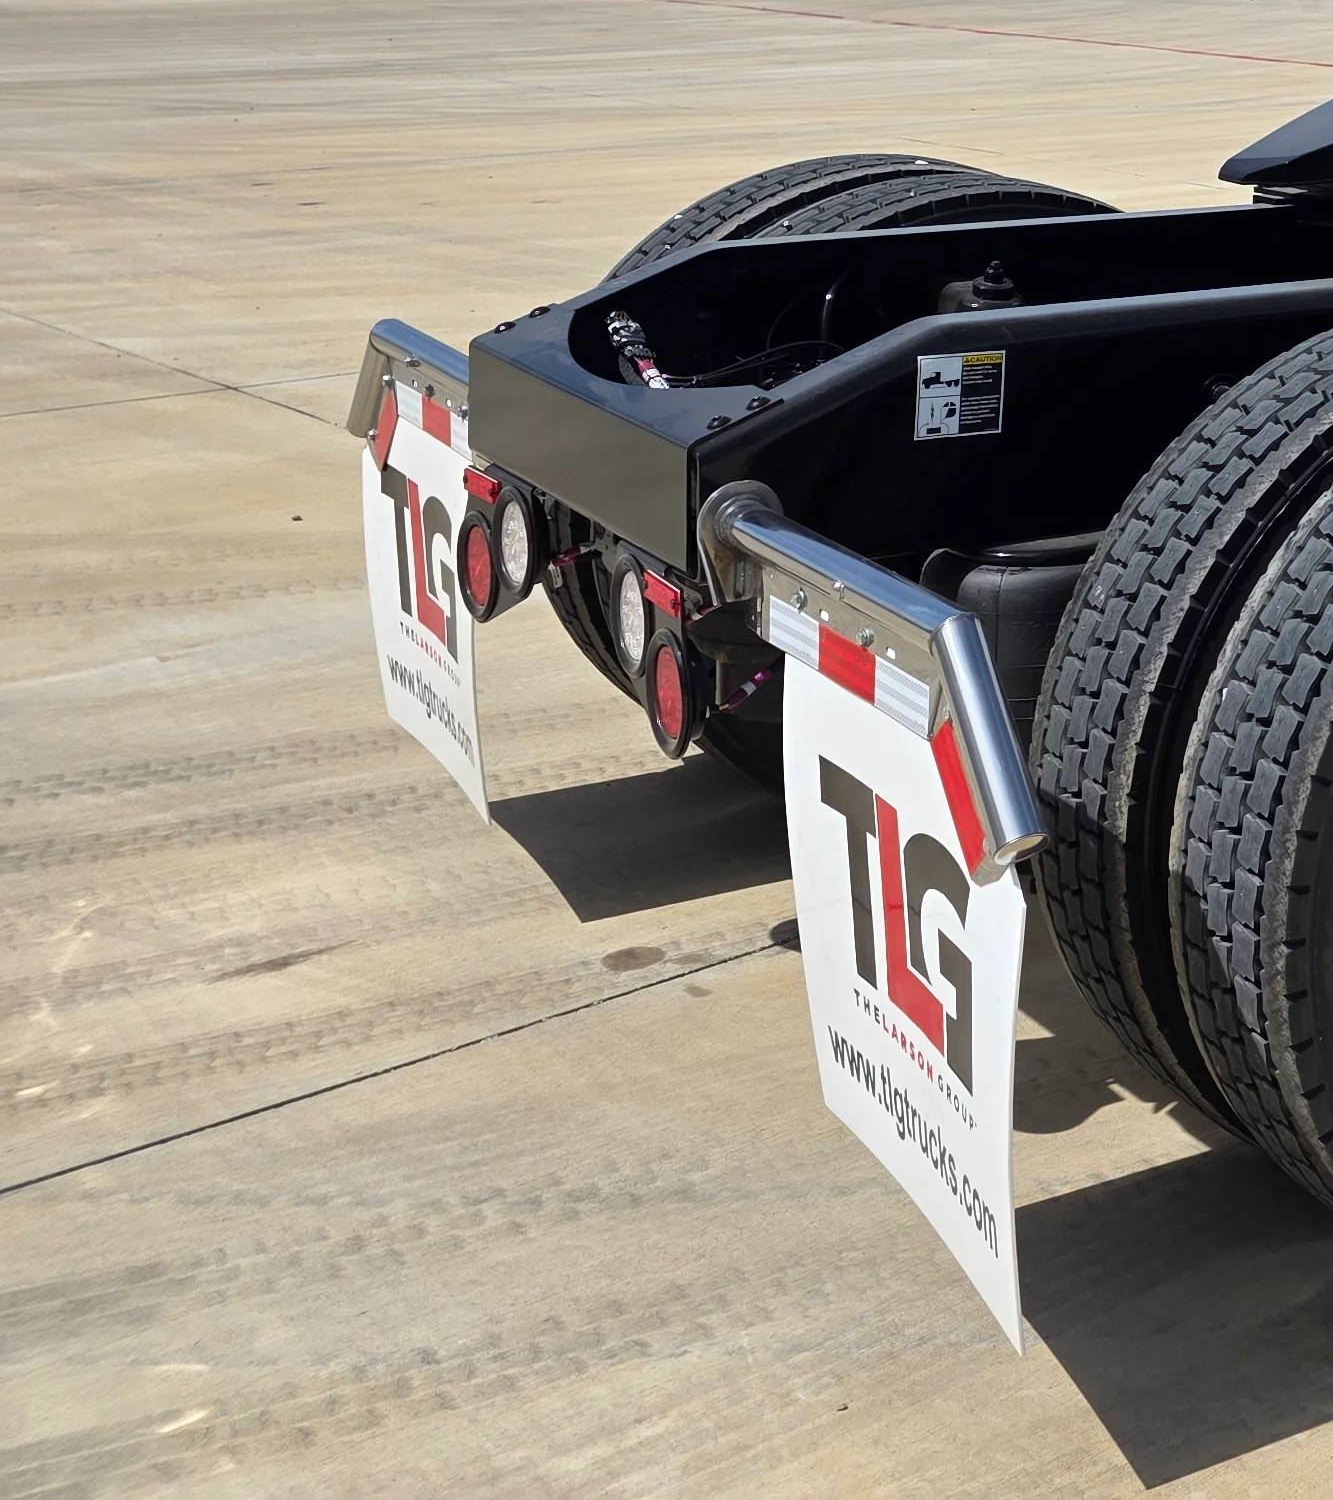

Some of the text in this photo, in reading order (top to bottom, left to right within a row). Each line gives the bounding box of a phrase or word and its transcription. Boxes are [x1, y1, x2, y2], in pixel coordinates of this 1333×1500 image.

[970, 355, 1002, 363] CAUTION
[381, 463, 459, 665] TLG
[387, 655, 475, 768] www.tlgtrucks.com
[818, 754, 973, 1097] TLG
[828, 1025, 999, 1259] www.tlgtrucks.com
[938, 1074, 974, 1130] GROUP
